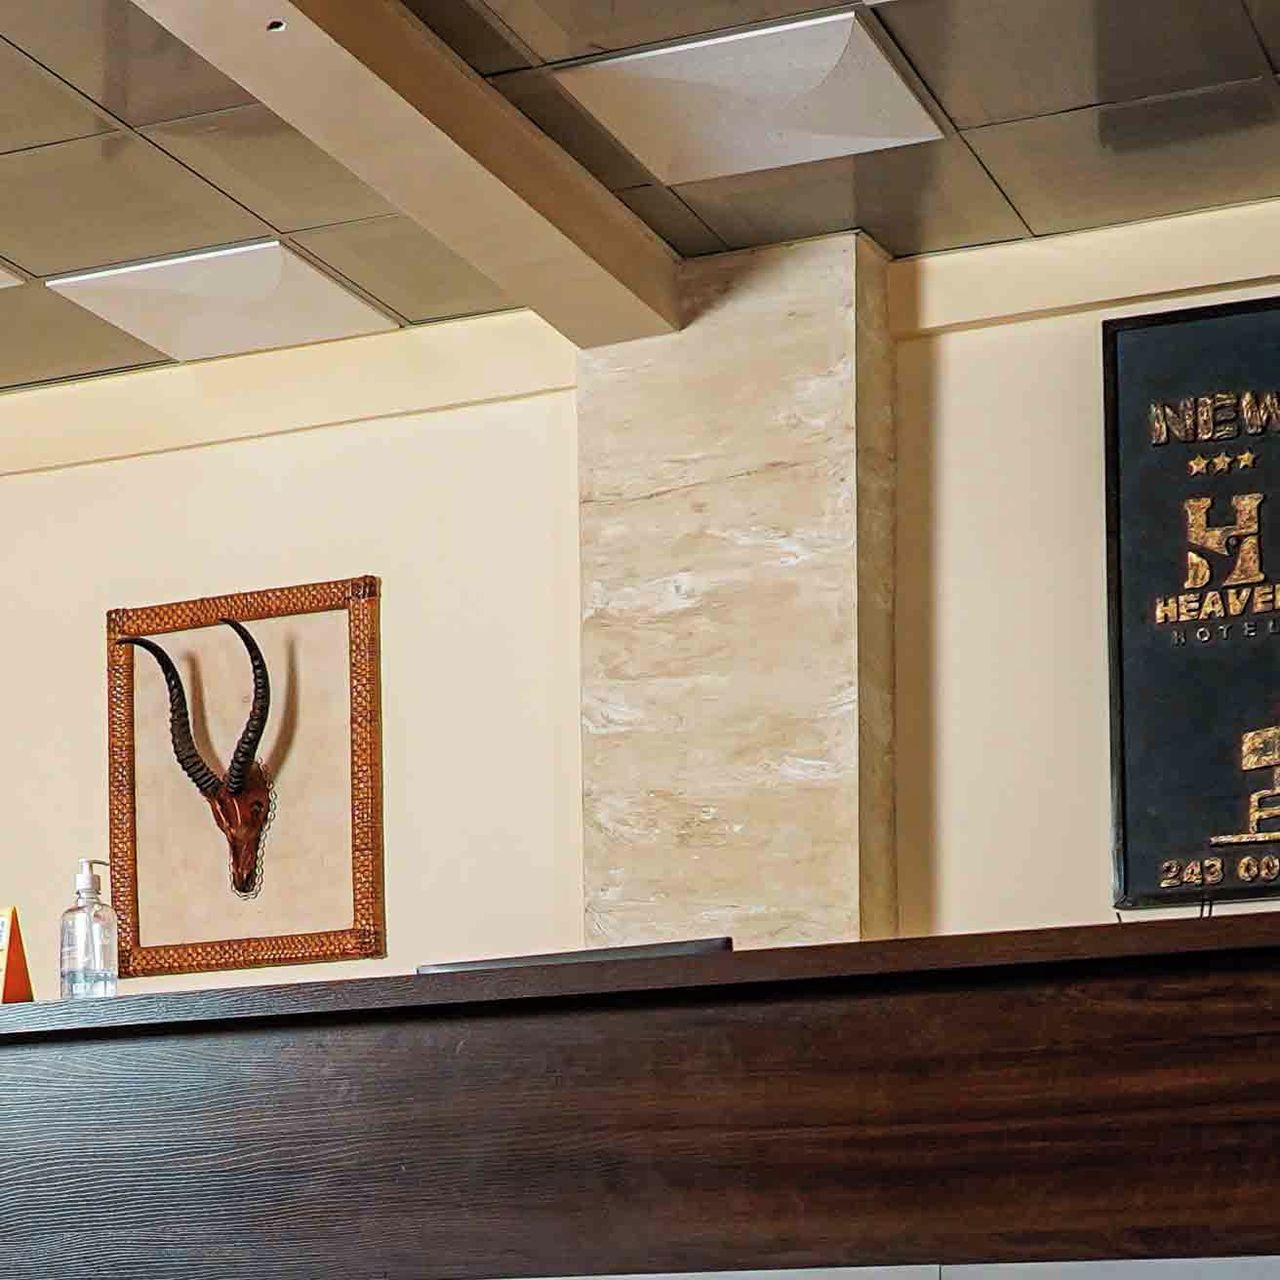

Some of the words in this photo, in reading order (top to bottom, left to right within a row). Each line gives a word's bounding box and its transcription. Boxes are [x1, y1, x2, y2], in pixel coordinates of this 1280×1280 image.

[1172, 620, 1280, 646] HOTEL
[1159, 855, 1225, 889] 243
[1237, 853, 1280, 882] 00
